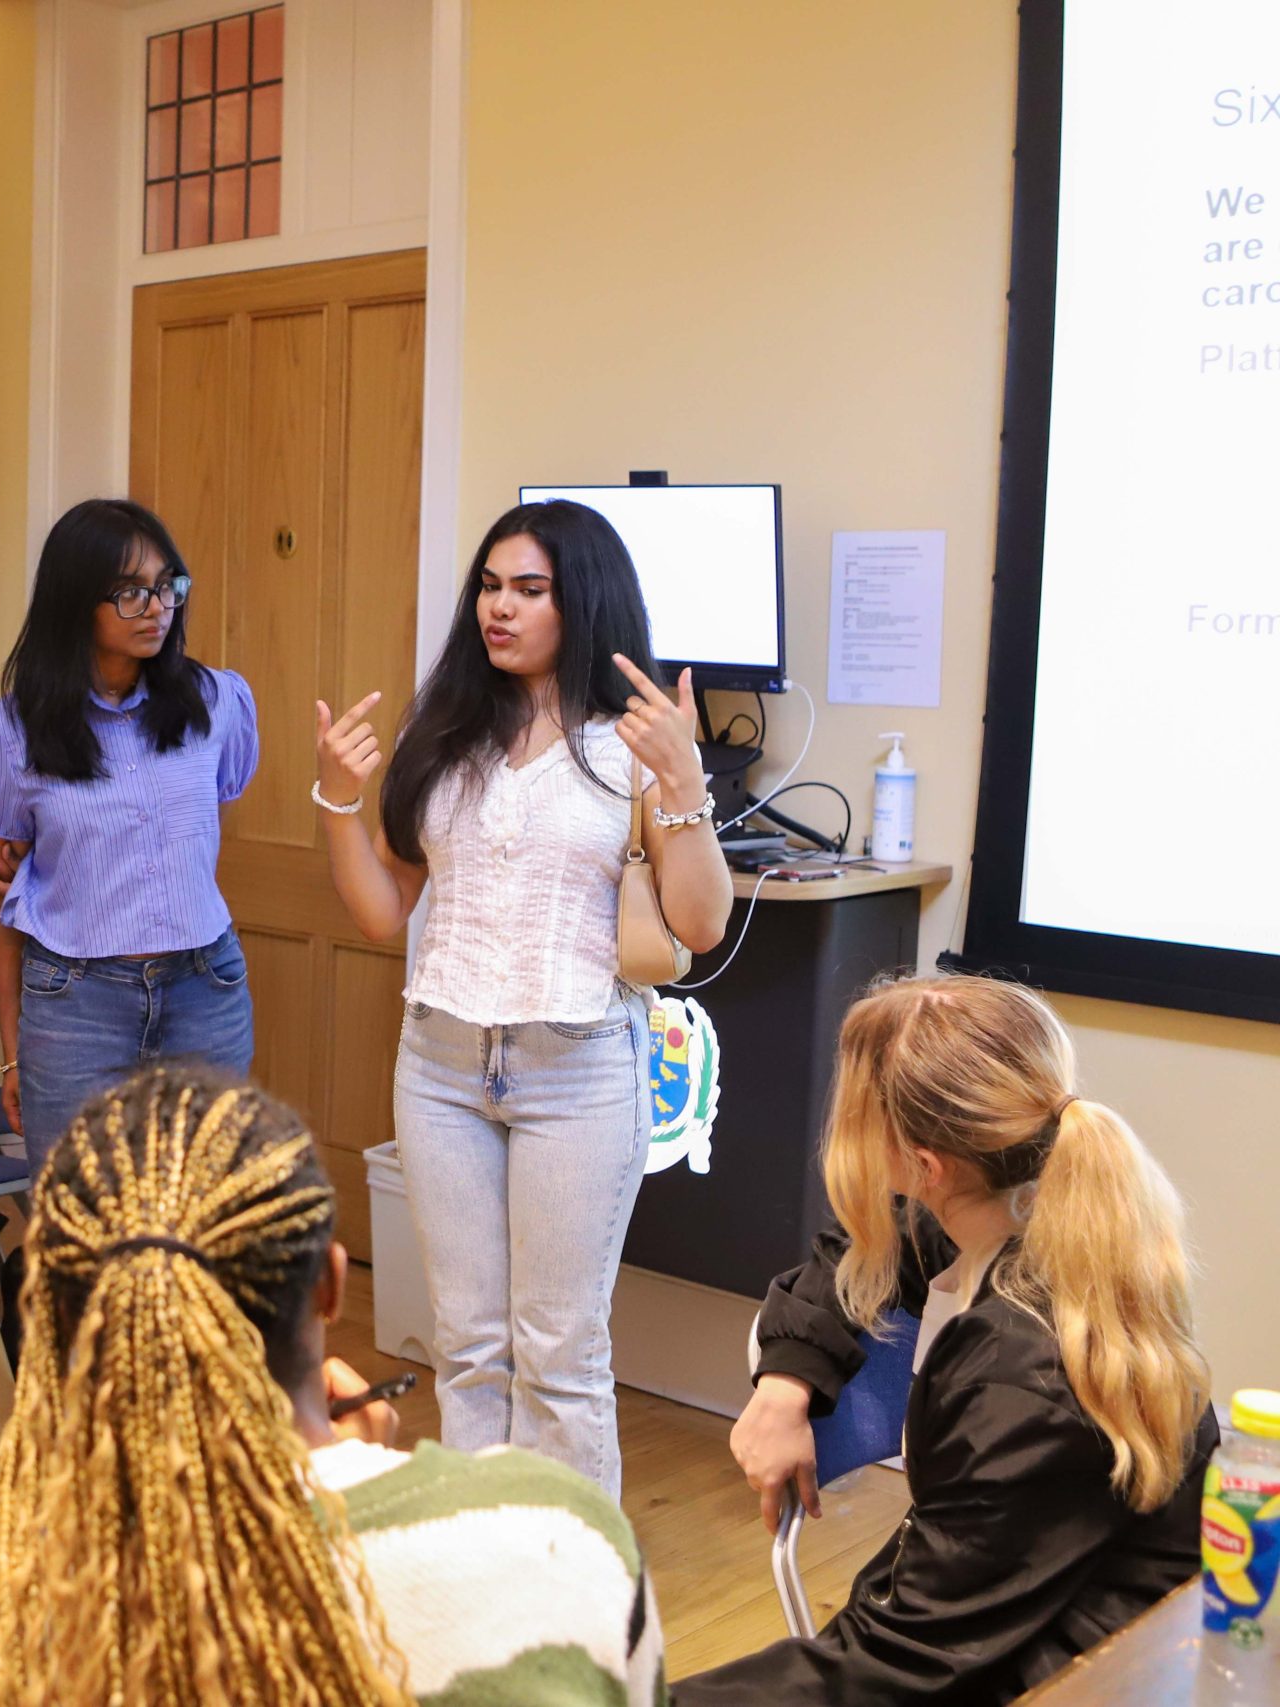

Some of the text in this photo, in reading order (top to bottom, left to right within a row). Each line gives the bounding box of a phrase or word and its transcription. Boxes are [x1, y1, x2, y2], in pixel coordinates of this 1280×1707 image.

[1212, 85, 1280, 127] Six
[1205, 186, 1264, 218] We
[1203, 238, 1263, 263] are
